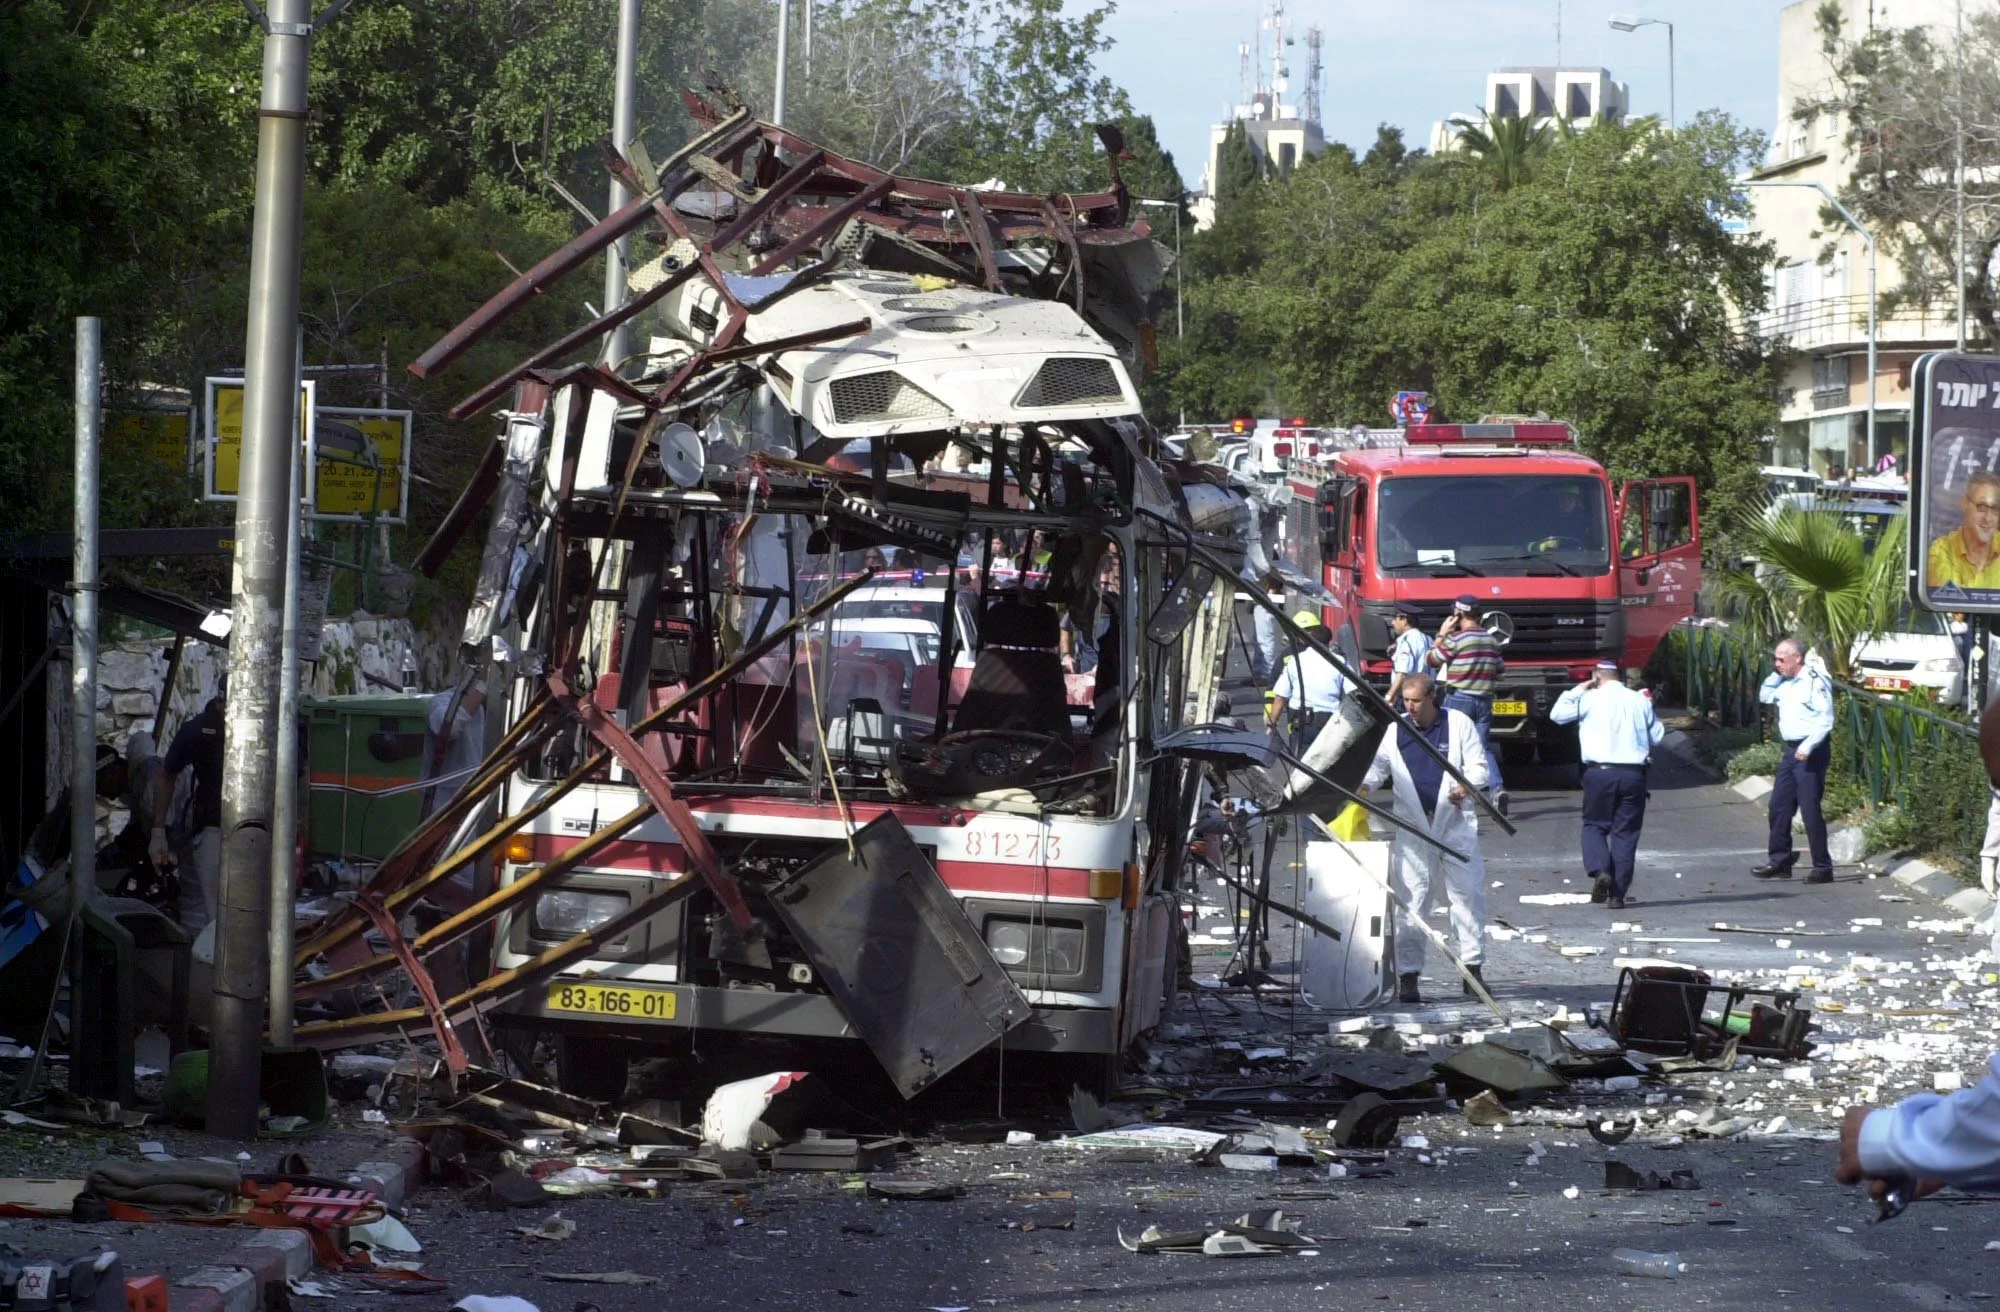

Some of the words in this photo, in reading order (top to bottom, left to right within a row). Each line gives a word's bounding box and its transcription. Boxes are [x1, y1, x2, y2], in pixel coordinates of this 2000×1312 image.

[1936, 381, 1987, 408] יותר
[1492, 702, 1523, 713] 89-15
[966, 831, 1061, 861] 81273
[561, 987, 665, 1017] 83-166-01
